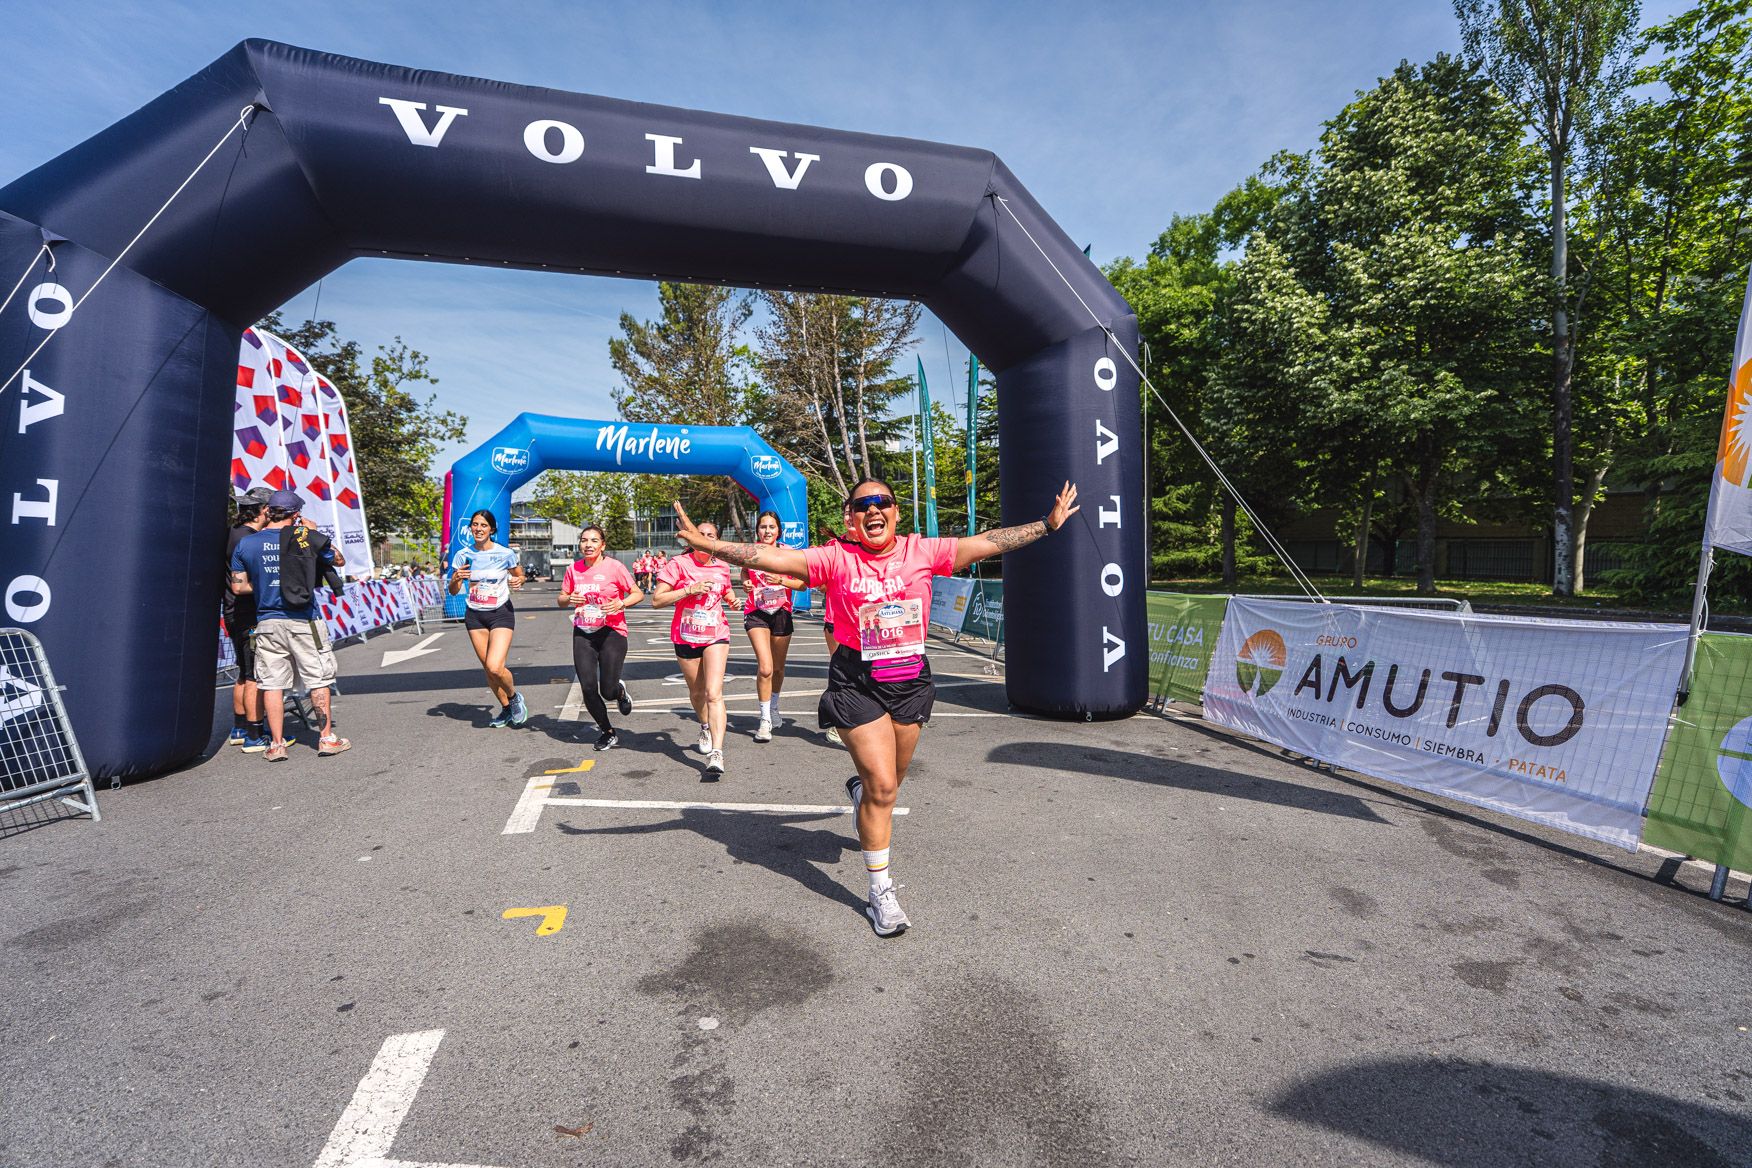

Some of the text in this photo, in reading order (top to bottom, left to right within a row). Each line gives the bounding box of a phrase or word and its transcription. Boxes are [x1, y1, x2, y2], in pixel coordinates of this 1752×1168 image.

[379, 96, 914, 202] VOLVO
[596, 424, 691, 466] Marlene
[1093, 356, 1126, 673] VOLVO
[881, 626, 904, 639] 016
[1166, 625, 1204, 647] CASA
[1316, 634, 1358, 649] GRUPO
[1149, 650, 1199, 669] onfianza
[1293, 653, 1585, 747] AMUTIO
[1287, 707, 1567, 783] INDUSTRIA CONSUMO SIEMBRA PATATA
